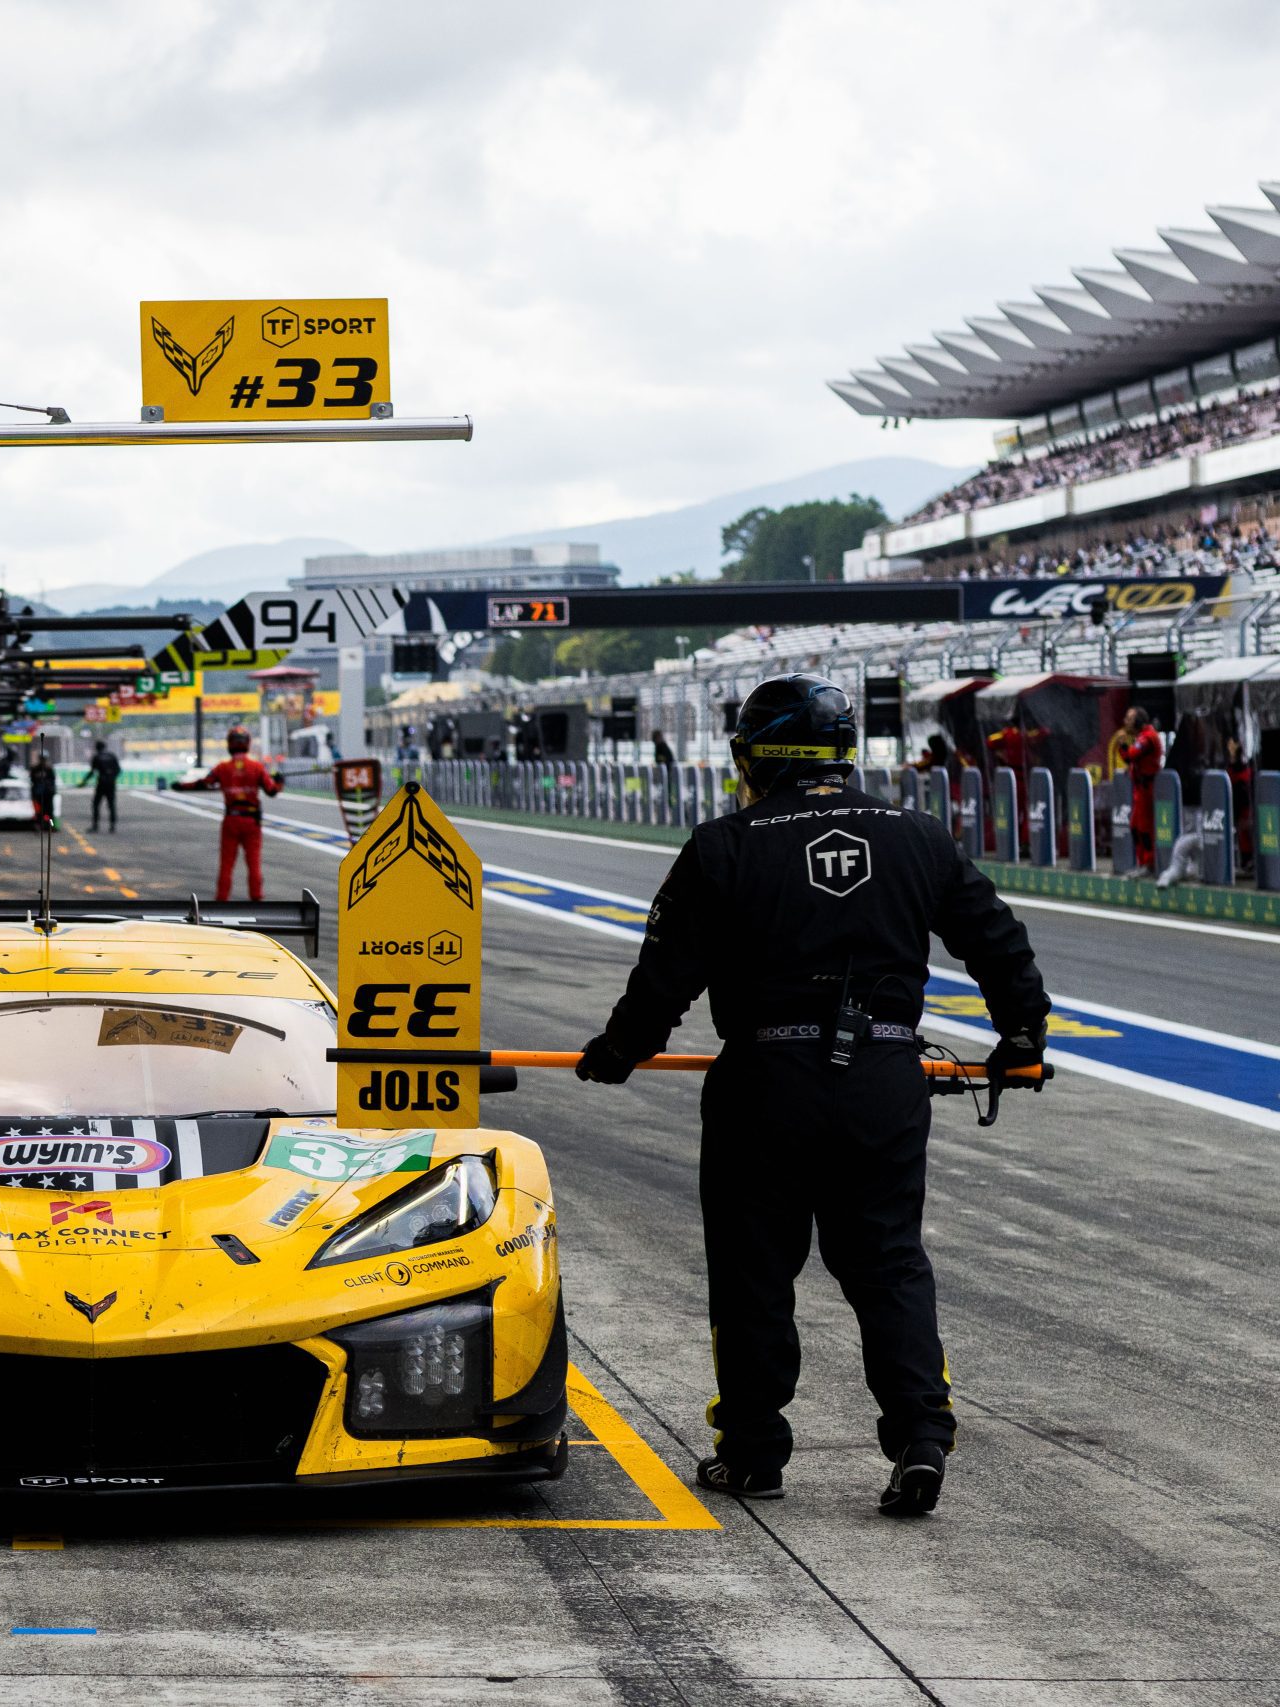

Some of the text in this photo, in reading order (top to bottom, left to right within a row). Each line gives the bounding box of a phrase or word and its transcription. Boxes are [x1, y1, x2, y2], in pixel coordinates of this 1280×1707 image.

[267, 318, 376, 335] TF SPORT
[990, 583, 1105, 615] WEC
[261, 599, 336, 644] 94
[494, 601, 557, 621] LAP 71
[345, 767, 369, 788] 54
[750, 808, 902, 826] CORVETTE
[816, 849, 860, 878] TF
[359, 941, 458, 955] TF SPORT
[347, 983, 470, 1038] 33
[756, 1024, 820, 1038] sparco
[359, 1071, 459, 1112] STOP
[289, 1141, 408, 1178] 33
[38, 1237, 133, 1248] DIGITAL
[58, 1227, 172, 1241] CONNECT
[344, 1256, 470, 1288] CLIENT COMMAND
